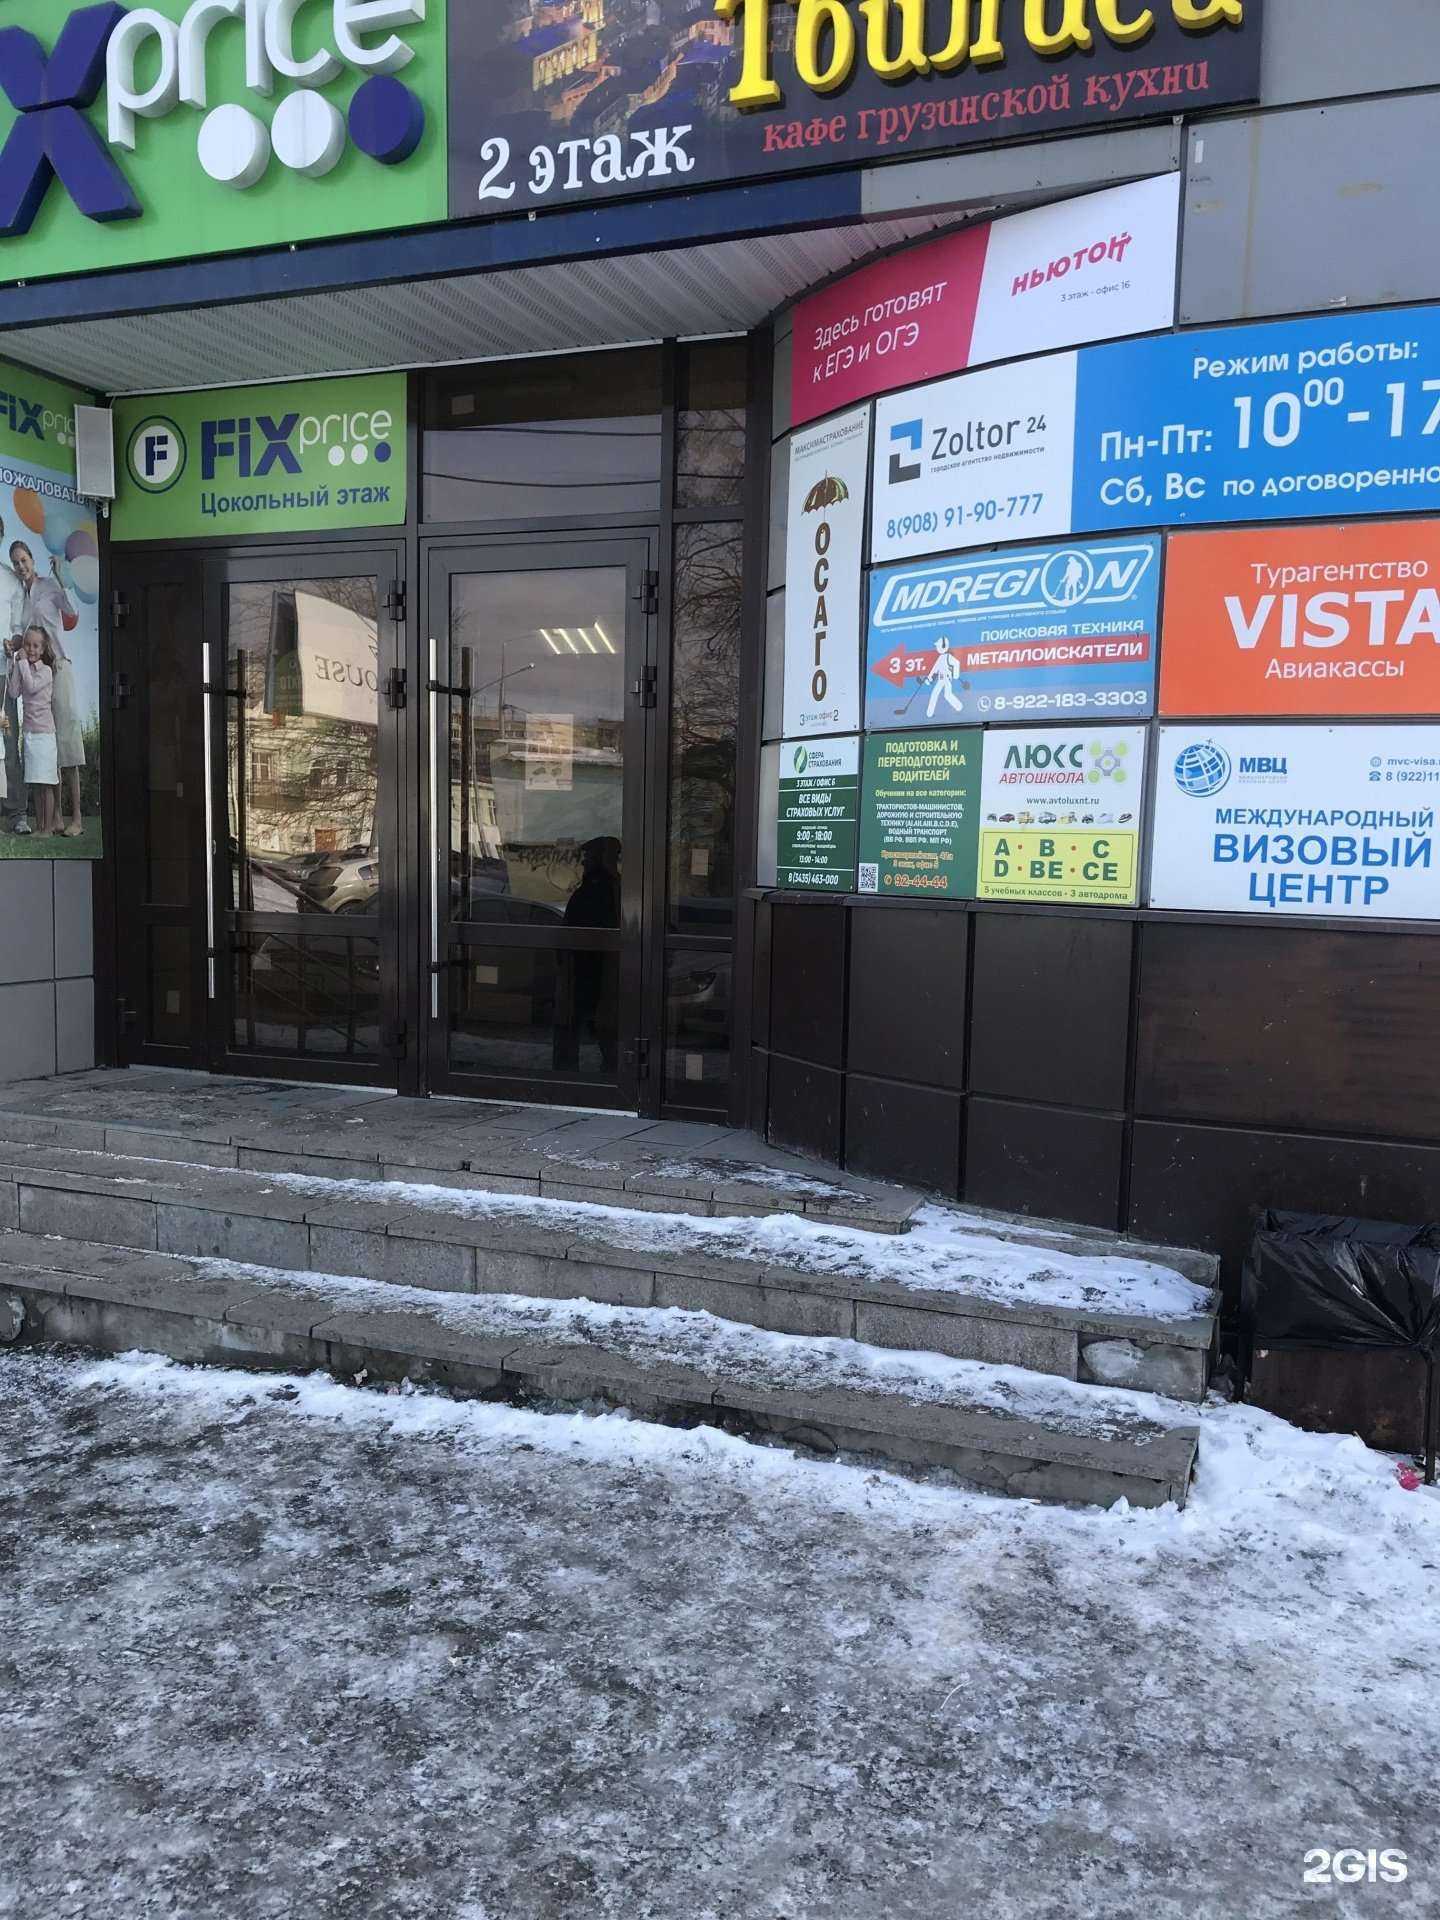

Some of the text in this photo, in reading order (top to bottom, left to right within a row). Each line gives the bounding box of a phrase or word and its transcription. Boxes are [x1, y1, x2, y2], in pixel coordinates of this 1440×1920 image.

[762, 60, 1209, 152] кафе грузинской кухни
[478, 124, 695, 200] 2 этаж
[1060, 294, 1066, 302] 3
[1067, 290, 1088, 300] этаж
[1120, 280, 1130, 289] 16
[813, 315, 860, 350] Здесь
[813, 322, 920, 383] к ЕГЭ и ОГЭ
[1193, 340, 1418, 379] Режим работы:
[931, 414, 1047, 461] Zoltor 24
[1100, 424, 1213, 462] Пн-Пт:
[1100, 475, 1152, 507] Сб,
[1165, 472, 1206, 500] Вс
[1223, 478, 1254, 497] по
[201, 485, 391, 517] Цокольный этаж
[886, 493, 1044, 539] 8(908) 91-90-777
[1251, 560, 1428, 588] Турагентство
[811, 522, 830, 702] ОСАГО
[1224, 587, 1440, 649] VISTA
[980, 624, 1067, 642] ПОИСКОВАЯ
[1072, 620, 1144, 636] ТЕХНИКА
[889, 658, 901, 673] 3
[967, 642, 1143, 666] МЕТАЛЛОИСКАТЕЛИ
[1265, 658, 1404, 679] Авиакассы
[994, 690, 1147, 710] 8-922-183-3303
[833, 709, 839, 721] 2
[808, 751, 824, 760] СФЕРА
[886, 740, 958, 754] ПОДГОТОВКА И
[1004, 744, 1084, 769] ЛЮКС
[808, 758, 842, 769] СТРАХОВАНИЯ
[878, 755, 966, 768] ПЕРЕПОДГОТОВКА
[1240, 757, 1288, 774] МВЦ
[892, 767, 950, 782] ВОДИТЕЛЕЙ
[998, 771, 1085, 784] АВТОШКОЛА
[1386, 771, 1393, 781] 8
[799, 793, 831, 804] ВСЕ ВИДЫ
[1026, 796, 1100, 806] www.avtoluxnt.ru
[786, 806, 845, 817] СТРАХОВЫХ УСЛУГ
[1215, 806, 1434, 829] МЕЖДУНАРОДНЫЙ
[994, 838, 1110, 858] A B C
[1213, 830, 1432, 868] ВИЗОВЫЙ
[788, 872, 792, 882] 8
[894, 873, 948, 888] 92-44-44
[994, 860, 1118, 881] D BE CE
[984, 886, 989, 894] 5
[991, 887, 1026, 897] учебных
[1028, 889, 1062, 897] классов
[1070, 889, 1076, 898] 3
[1078, 891, 1128, 900] автодрома
[1249, 872, 1389, 907] ЦЕНТР
